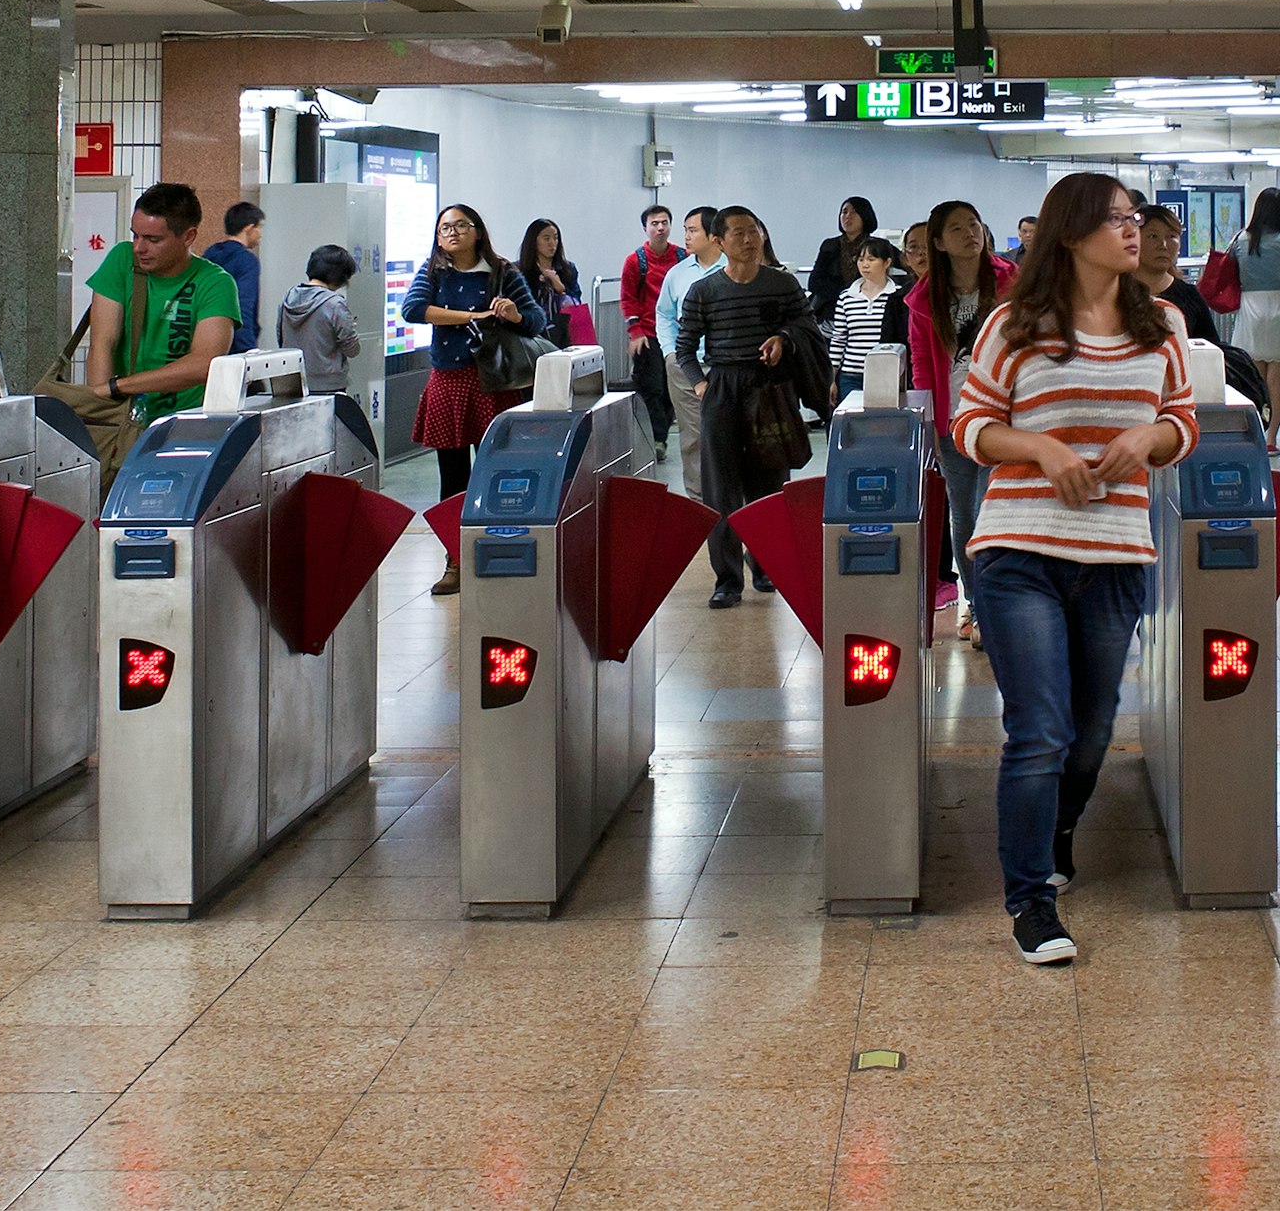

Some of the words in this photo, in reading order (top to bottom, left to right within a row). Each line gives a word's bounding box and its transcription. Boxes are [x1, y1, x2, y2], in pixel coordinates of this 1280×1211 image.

[922, 81, 952, 113] B
[868, 107, 900, 117] EXIT
[961, 101, 996, 115] North
[1002, 101, 1026, 114] Exit
